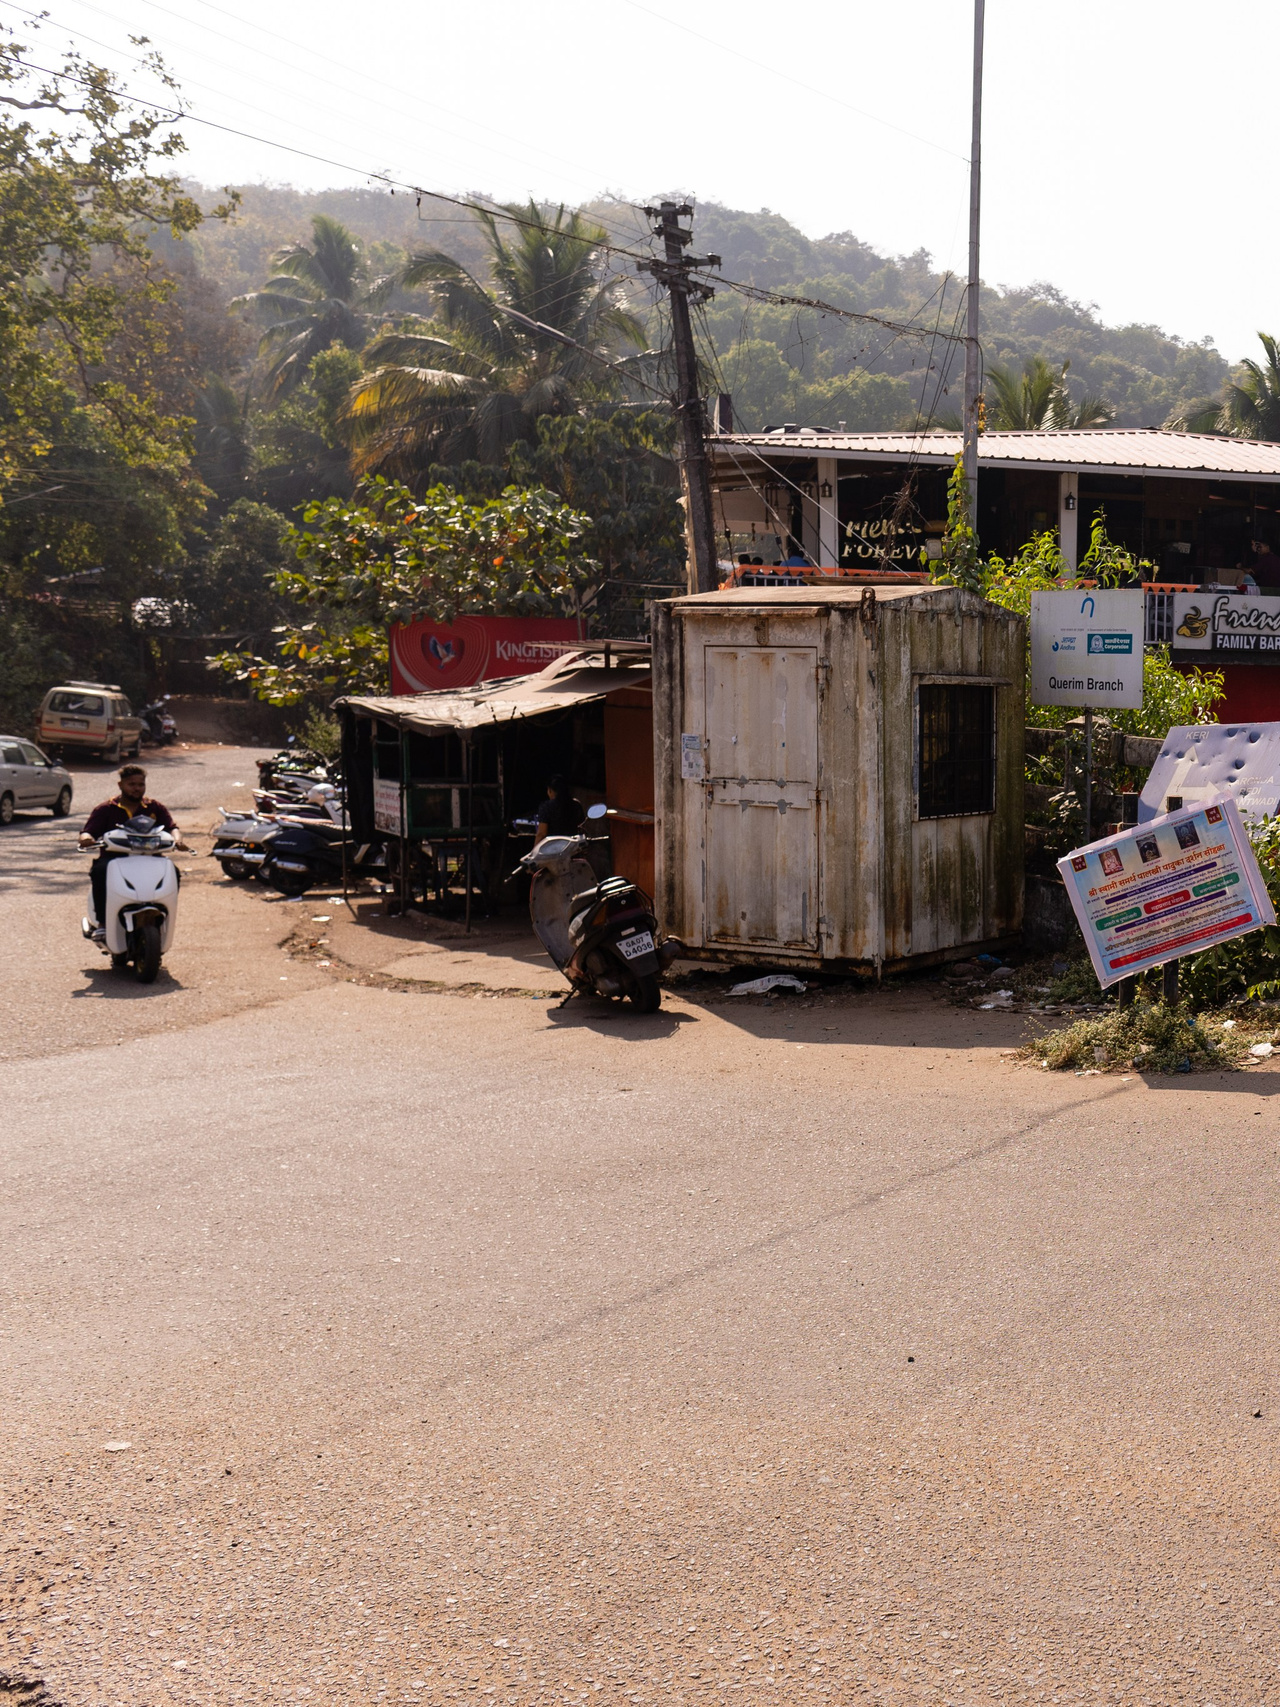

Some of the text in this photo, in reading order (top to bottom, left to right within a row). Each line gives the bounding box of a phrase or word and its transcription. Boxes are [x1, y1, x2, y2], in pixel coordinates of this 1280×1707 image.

[841, 544, 927, 559] FOREV
[1216, 635, 1256, 650] FAMILY
[496, 640, 567, 661] KINGFISH
[1049, 676, 1124, 691] Querim Branch
[1185, 731, 1210, 740] KERI
[1087, 888, 1096, 896] श्री
[1097, 881, 1117, 893] स्वामी
[1117, 874, 1135, 886] समर्थ
[1162, 859, 1184, 872] पादुका
[1184, 851, 1202, 863] दर्शन
[625, 941, 653, 957] D4036
